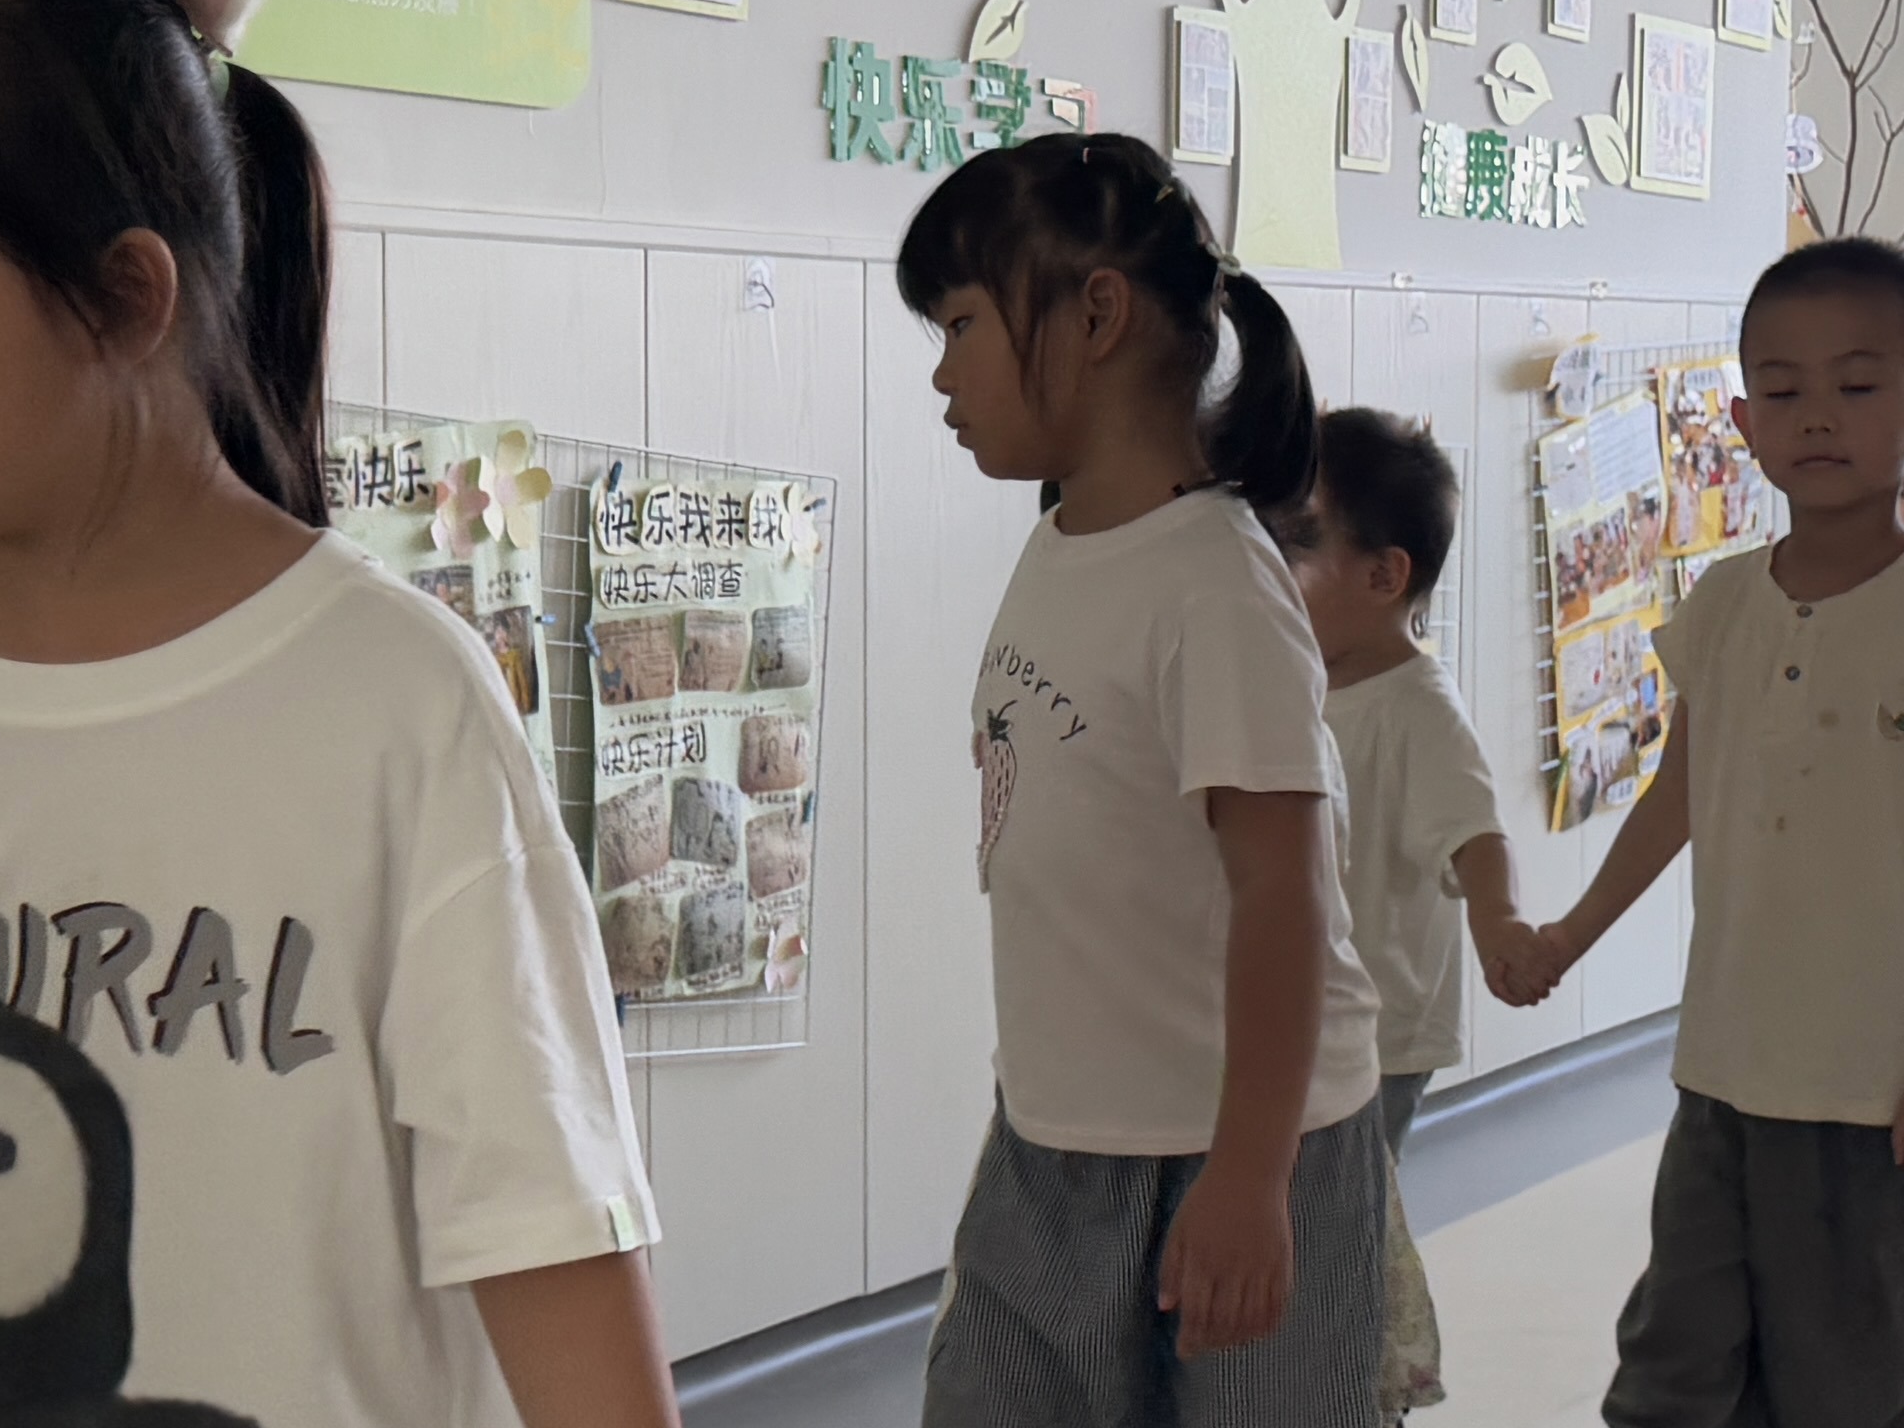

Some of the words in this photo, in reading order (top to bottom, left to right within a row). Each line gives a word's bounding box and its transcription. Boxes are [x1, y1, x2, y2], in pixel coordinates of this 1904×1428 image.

[1419, 119, 1591, 230] 健康成长
[603, 559, 744, 604] 快乐大调查
[599, 721, 707, 777] 快乐计划
